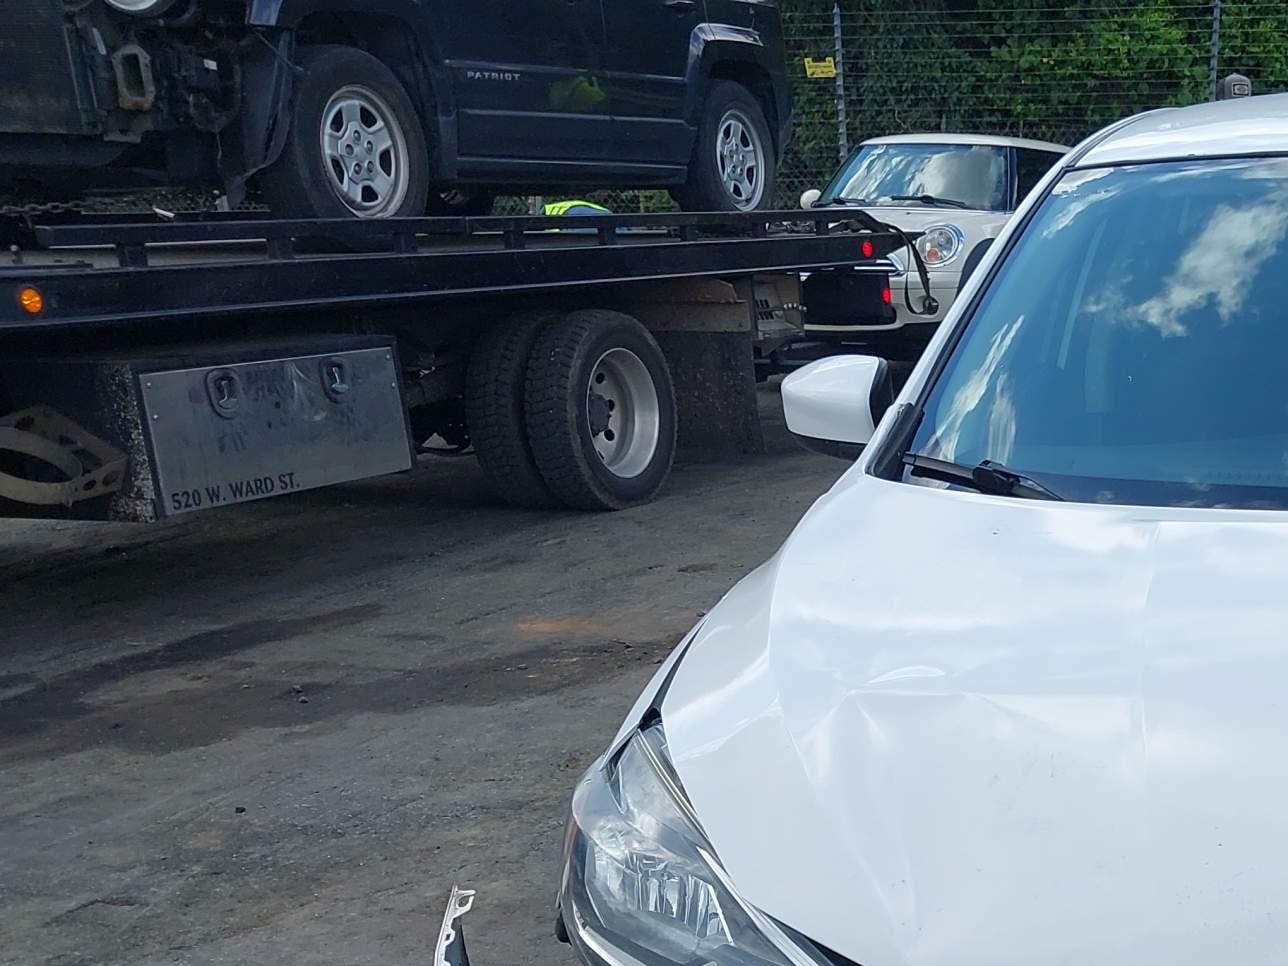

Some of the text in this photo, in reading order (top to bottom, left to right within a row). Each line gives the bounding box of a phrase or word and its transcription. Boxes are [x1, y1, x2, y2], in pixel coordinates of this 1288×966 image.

[466, 71, 521, 81] PATRIOT
[171, 473, 300, 511] 520 W. WARD ST.
